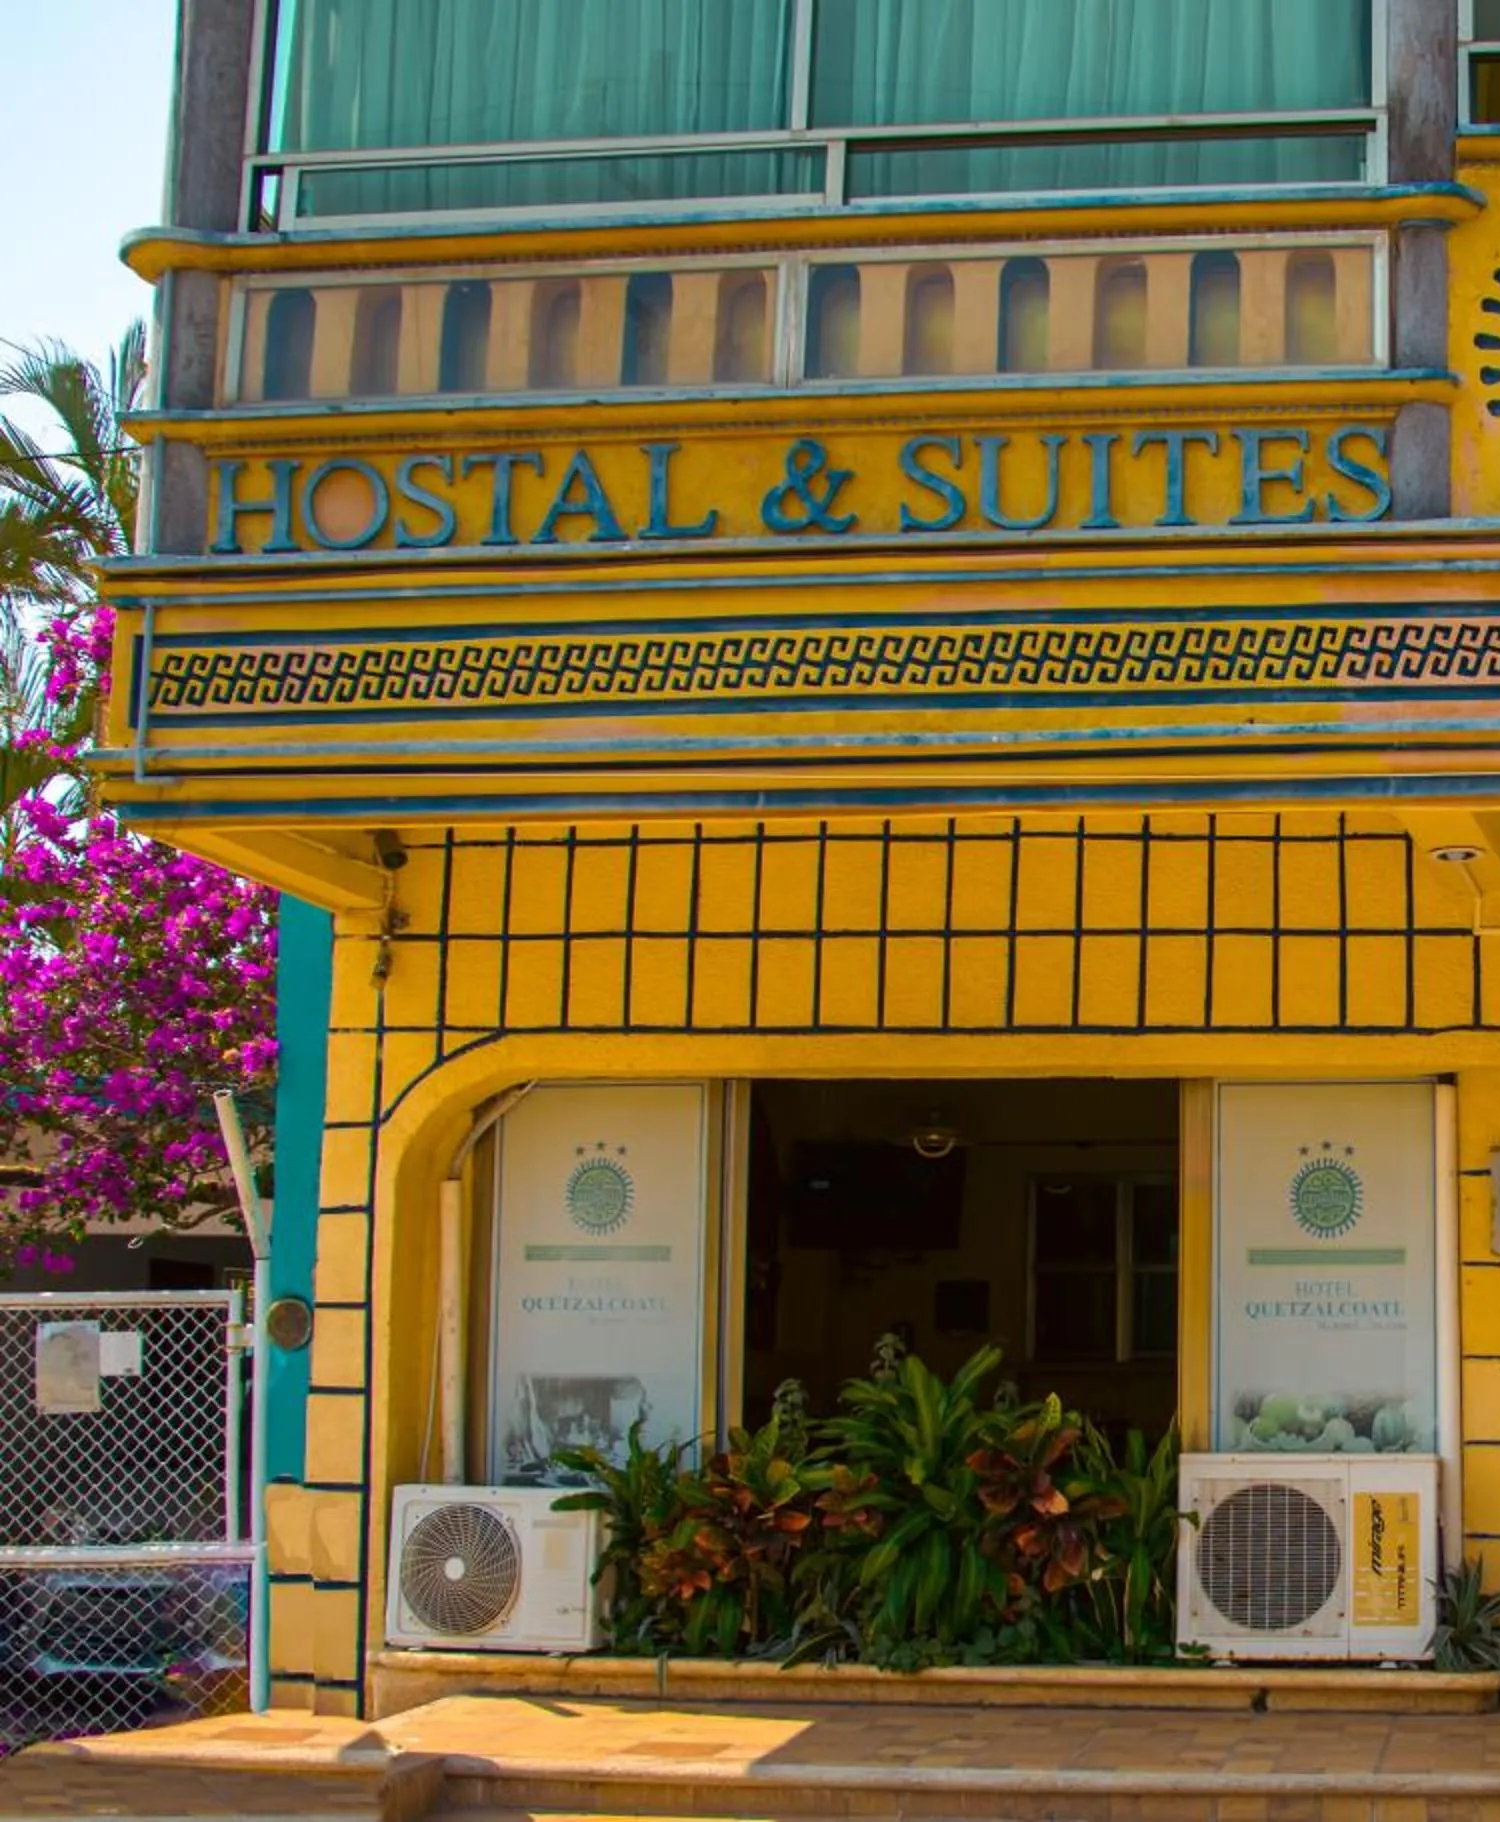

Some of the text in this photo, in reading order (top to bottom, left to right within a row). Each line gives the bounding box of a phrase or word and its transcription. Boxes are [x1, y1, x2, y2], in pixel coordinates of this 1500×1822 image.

[208, 425, 1393, 553] HOSTAL & SUITES
[1295, 1279, 1358, 1298] HOTEL
[1244, 1300, 1405, 1319] QUETZALCOATL
